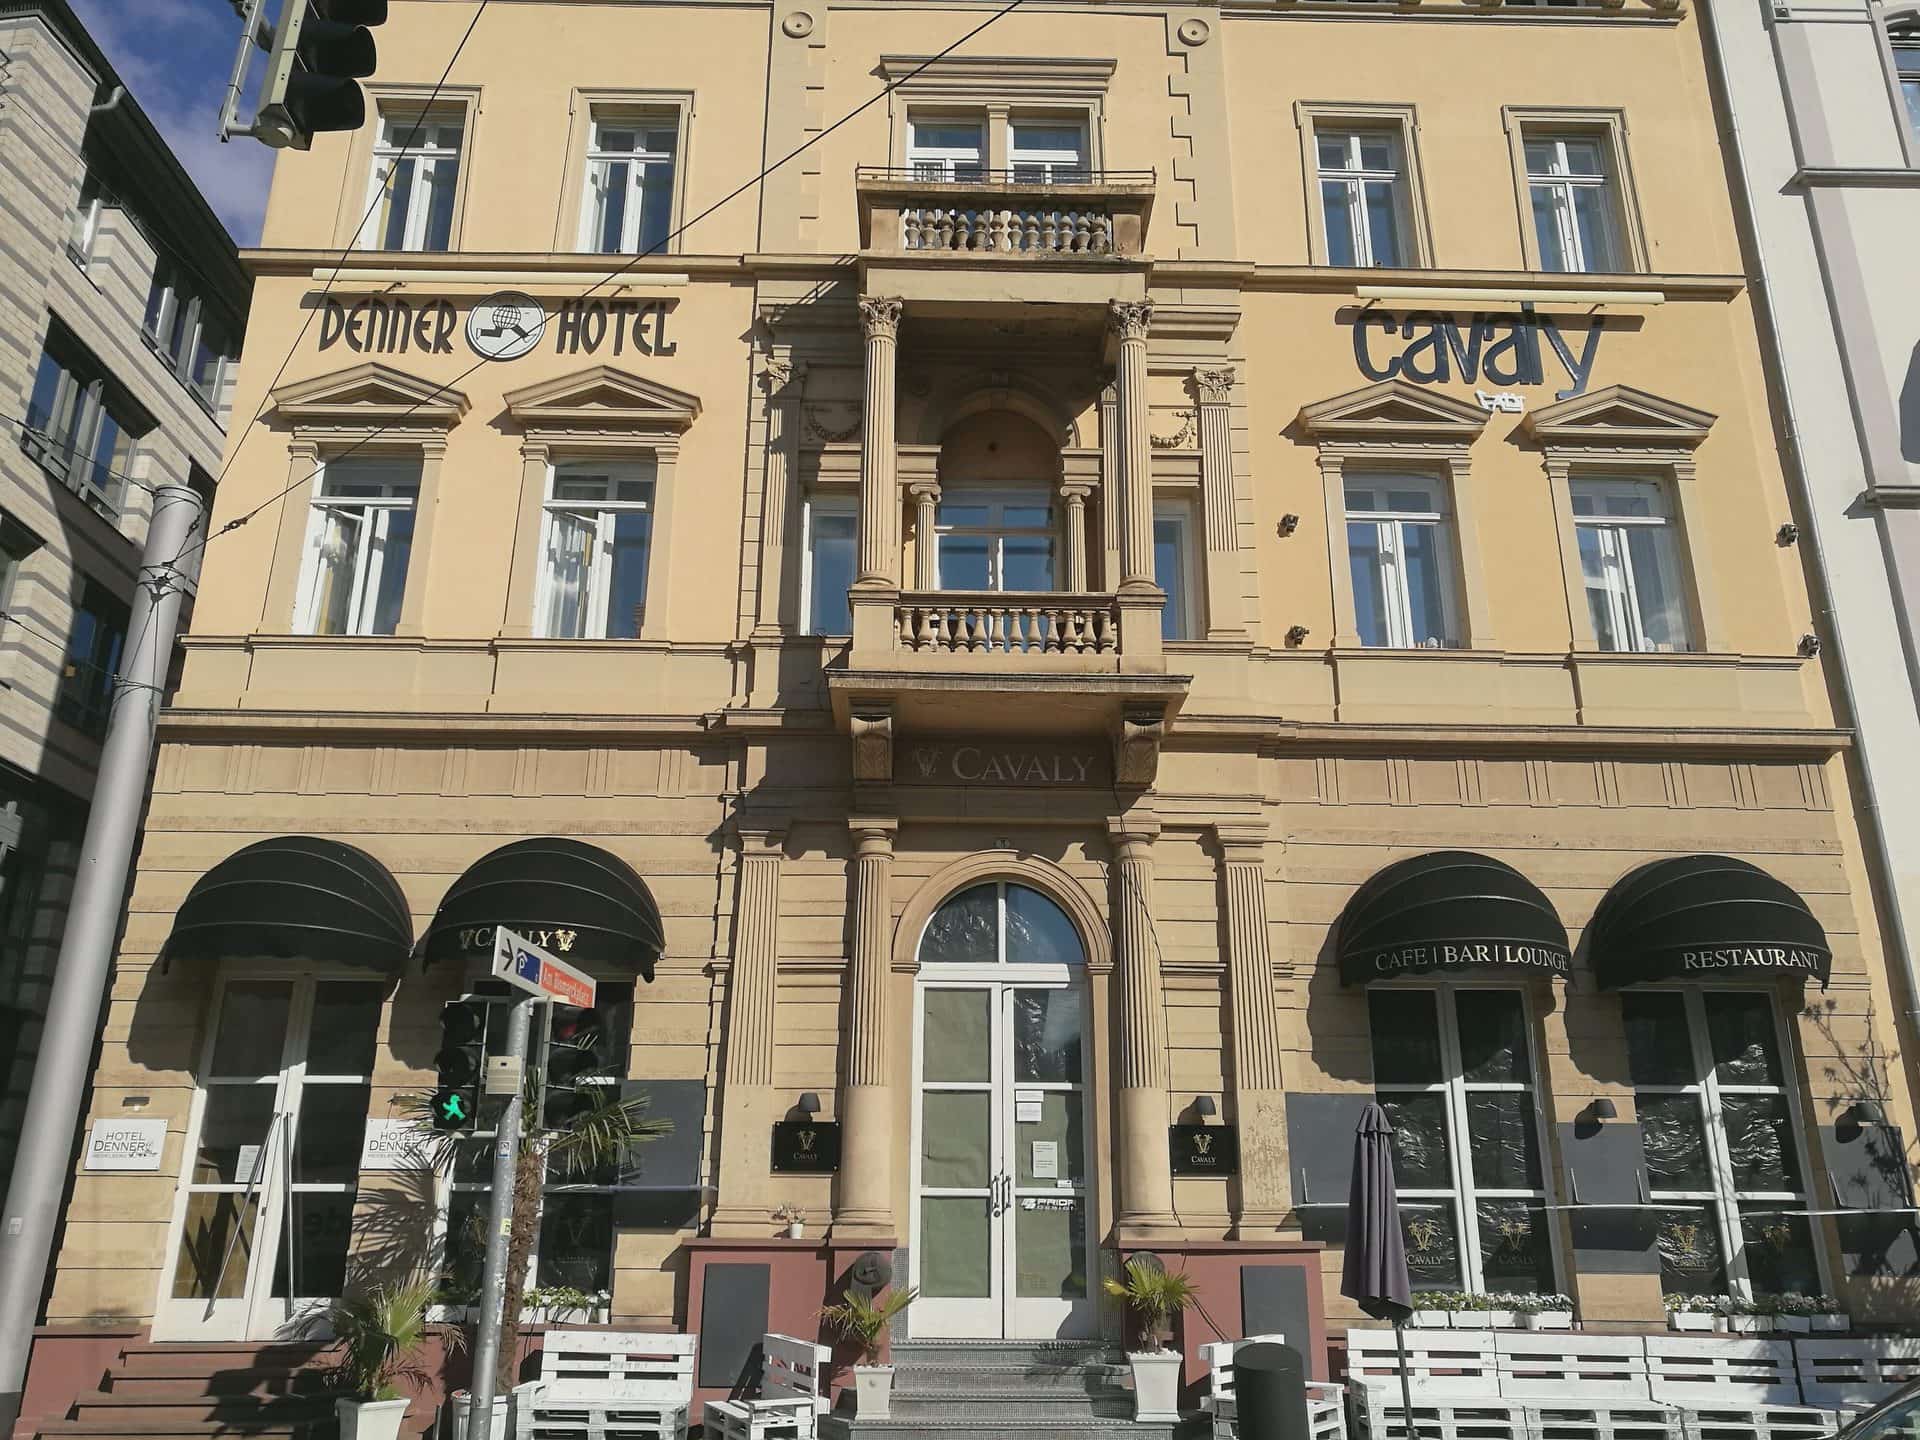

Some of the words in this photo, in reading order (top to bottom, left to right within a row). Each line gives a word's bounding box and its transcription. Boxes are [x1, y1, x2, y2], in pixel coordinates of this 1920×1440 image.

[319, 298, 457, 354] DENNER
[556, 298, 677, 357] HOTEL
[475, 928, 552, 948] CAALY
[1375, 948, 1428, 971] CAFE
[1443, 944, 1492, 963] BAR
[1503, 945, 1569, 972] LOUNGE
[1682, 949, 1819, 971] RESTAURANT
[105, 1131, 146, 1141] HOTEL
[380, 1131, 418, 1141] HOTEL
[94, 1140, 146, 1152] DENNER
[1406, 1254, 1442, 1265] CAVALY
